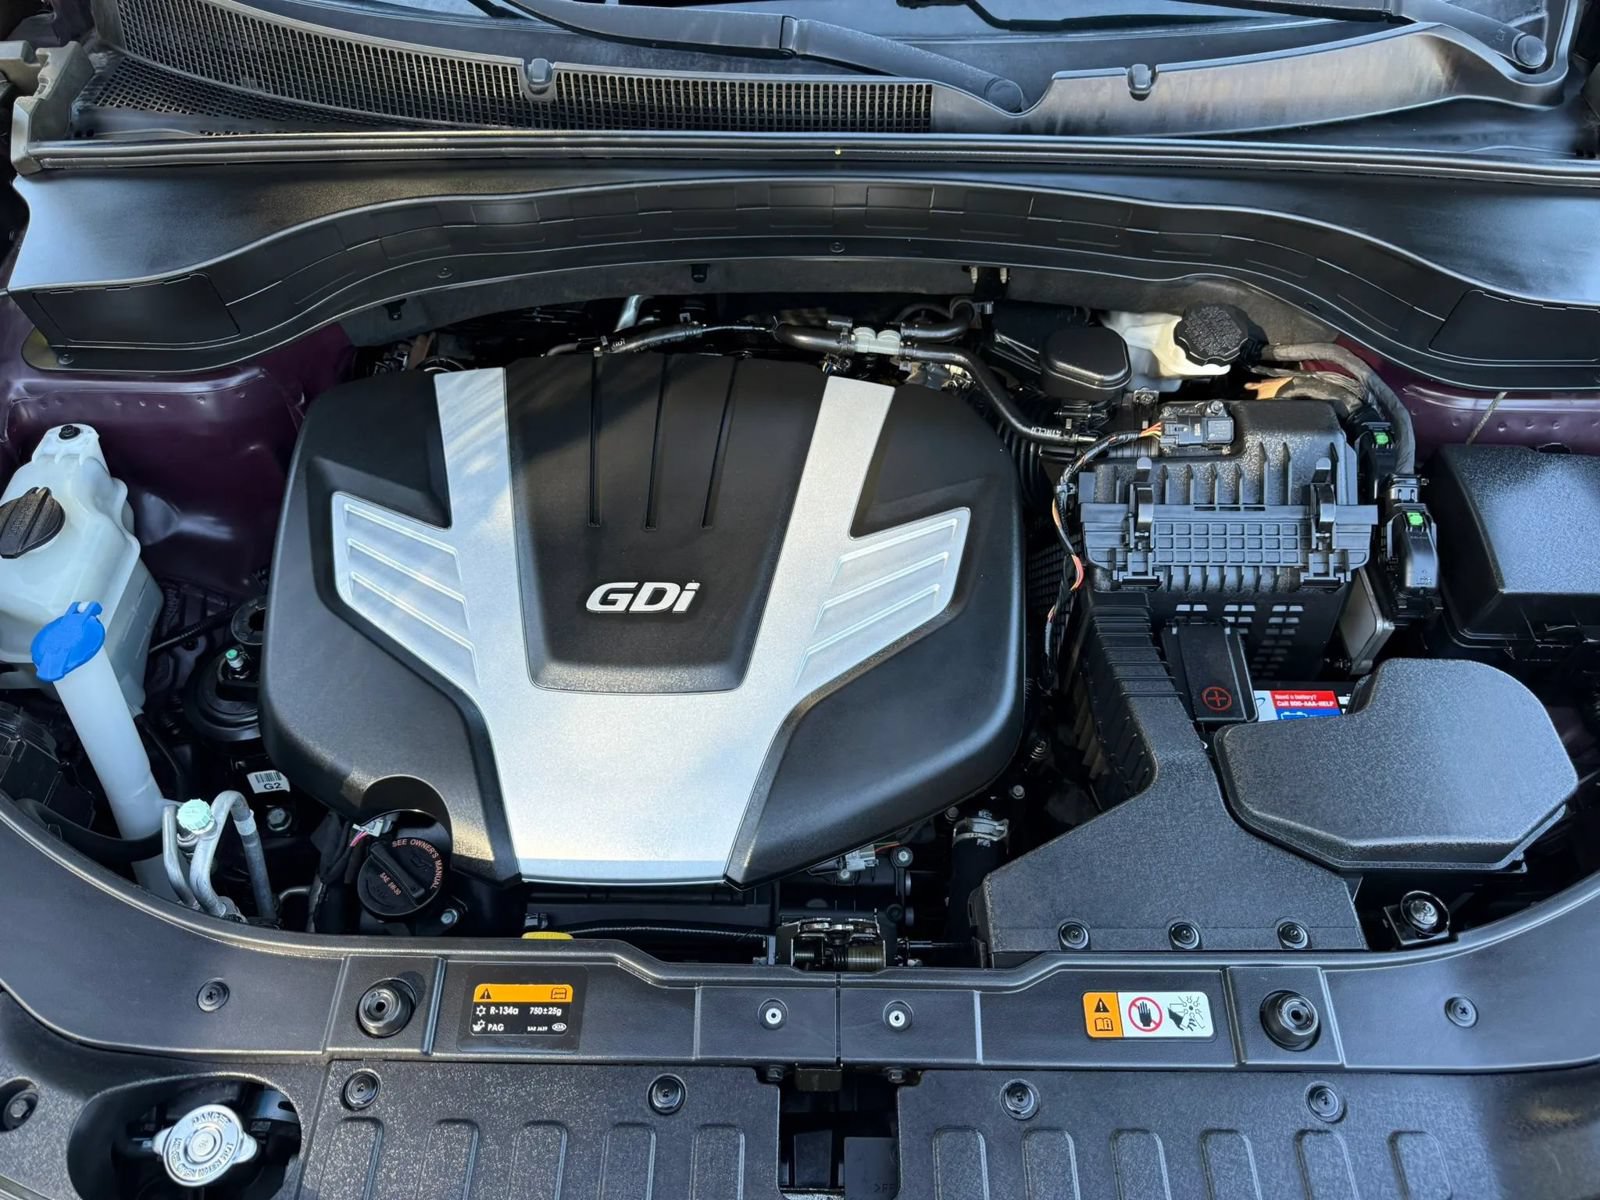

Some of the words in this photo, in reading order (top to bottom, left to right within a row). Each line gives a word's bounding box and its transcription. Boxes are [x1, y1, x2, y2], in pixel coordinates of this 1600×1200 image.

[586, 580, 700, 613] GDi
[264, 782, 282, 790] G2
[392, 839, 408, 848] SEE
[410, 839, 439, 859] OWNER'S
[431, 859, 443, 890] MANUAL
[489, 1006, 519, 1015] R-134a
[529, 1006, 562, 1016] 750±25g
[487, 1023, 504, 1032] PAG
